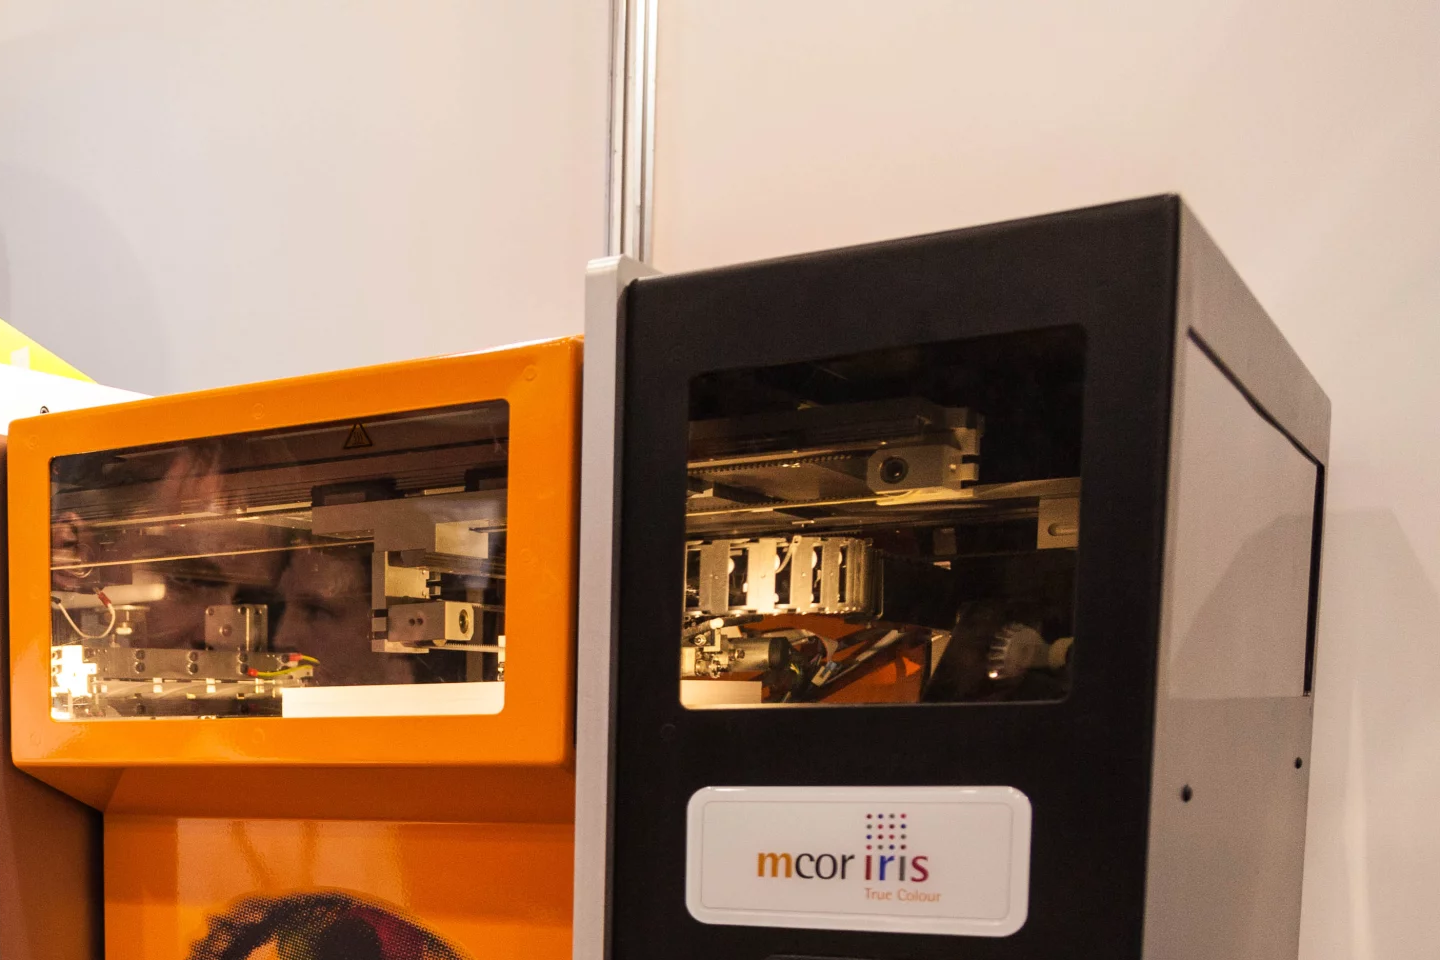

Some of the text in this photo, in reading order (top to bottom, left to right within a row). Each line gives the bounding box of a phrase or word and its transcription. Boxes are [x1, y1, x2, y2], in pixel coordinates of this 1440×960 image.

[756, 852, 856, 880] mcor
[864, 887, 942, 903] True Colour
